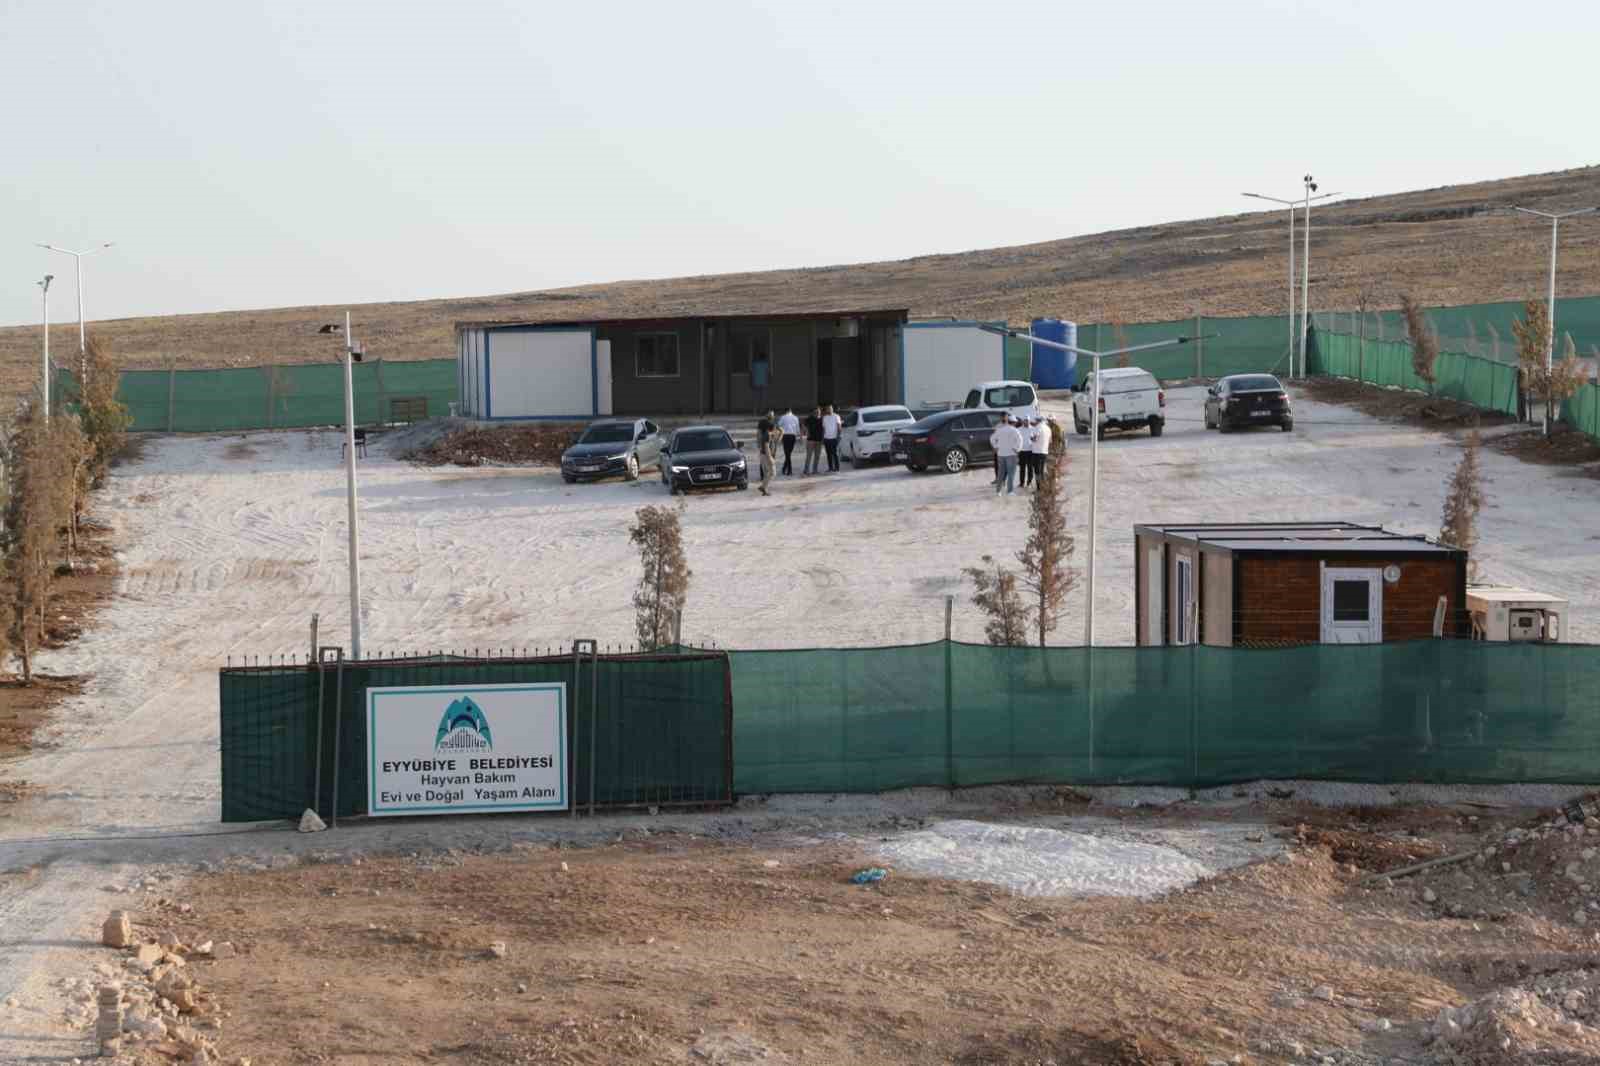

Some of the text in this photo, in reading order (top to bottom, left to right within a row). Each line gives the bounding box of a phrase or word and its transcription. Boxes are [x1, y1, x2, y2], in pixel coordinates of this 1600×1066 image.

[382, 755, 553, 772] EYYÜBİYE BELEDİYESİ
[421, 771, 516, 788] Hayvan Bakım
[381, 786, 555, 804] Evi ve Doğal Yaşam Alanı
